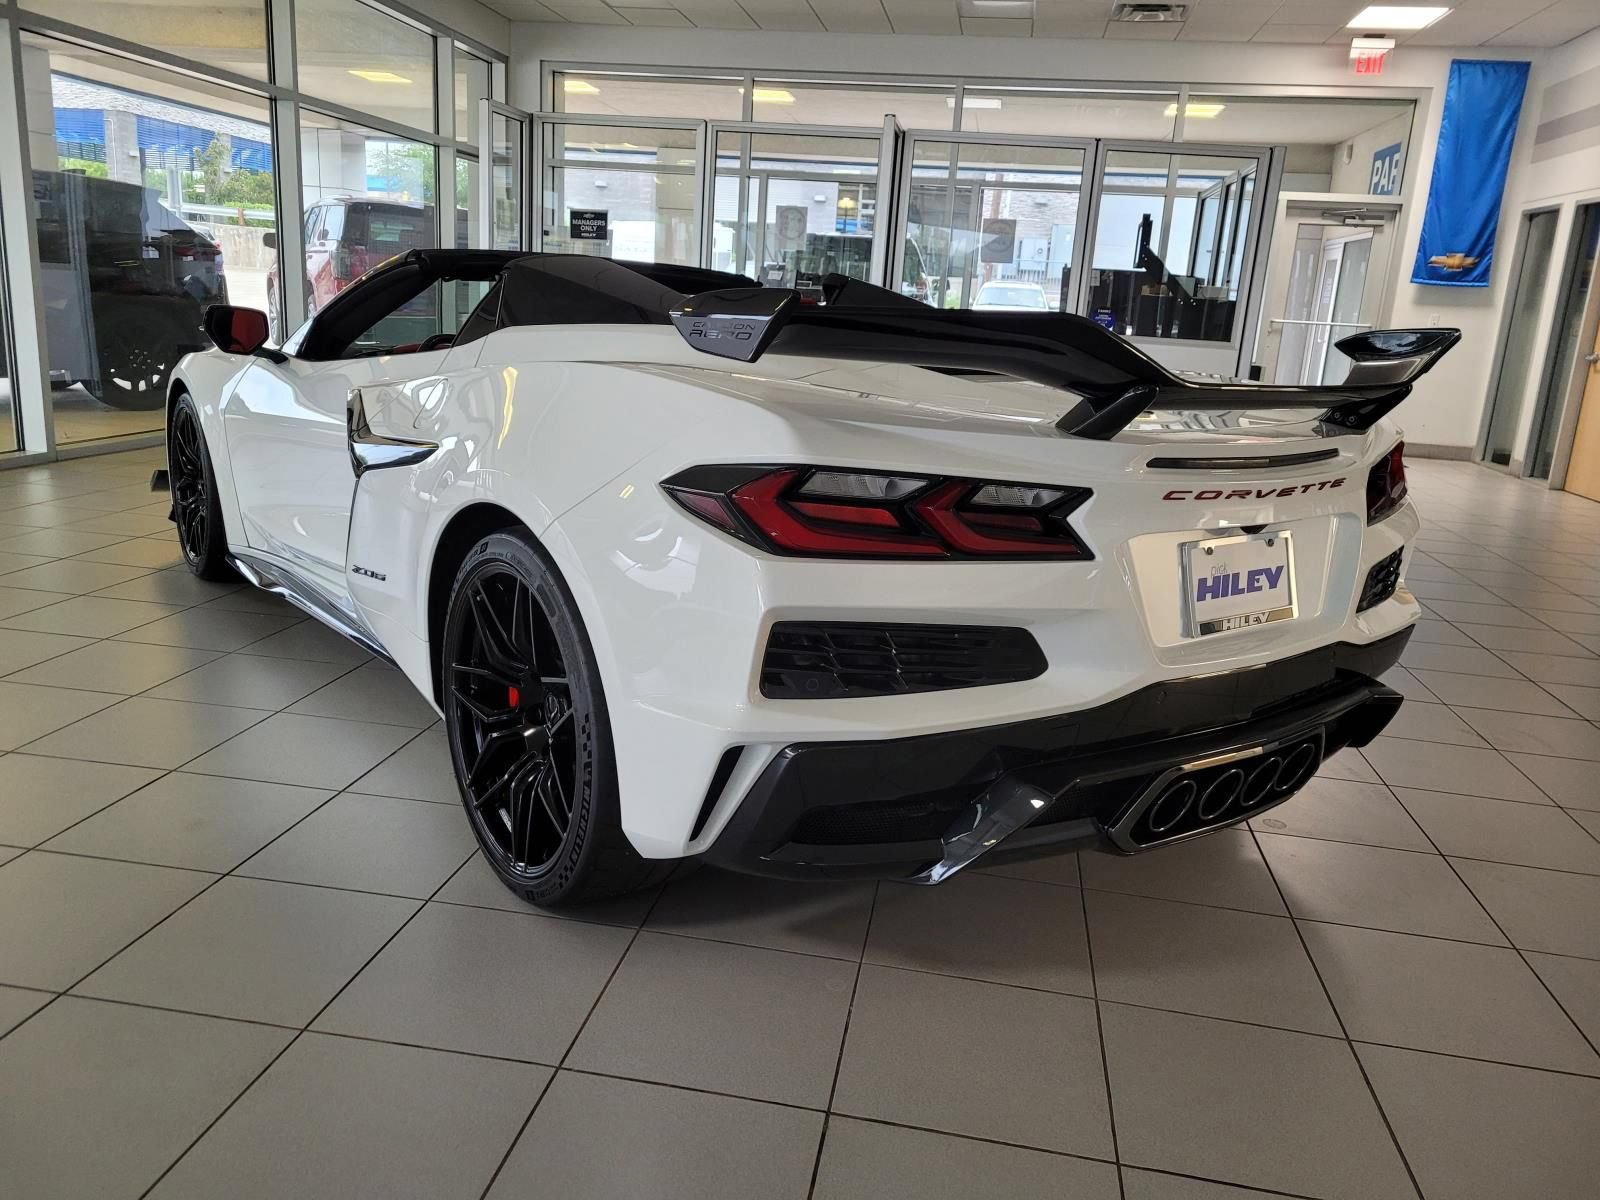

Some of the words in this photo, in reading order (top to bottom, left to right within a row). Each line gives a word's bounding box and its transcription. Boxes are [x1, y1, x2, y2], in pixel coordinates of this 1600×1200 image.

[1355, 53, 1386, 74] EXIT
[572, 218, 606, 226] MANAGERS
[1162, 477, 1347, 501] CORVETTE
[352, 564, 387, 582] Z06
[1196, 565, 1284, 603] HILEY
[1222, 612, 1270, 631] HILEY
[570, 783, 592, 867] MICHELIN
